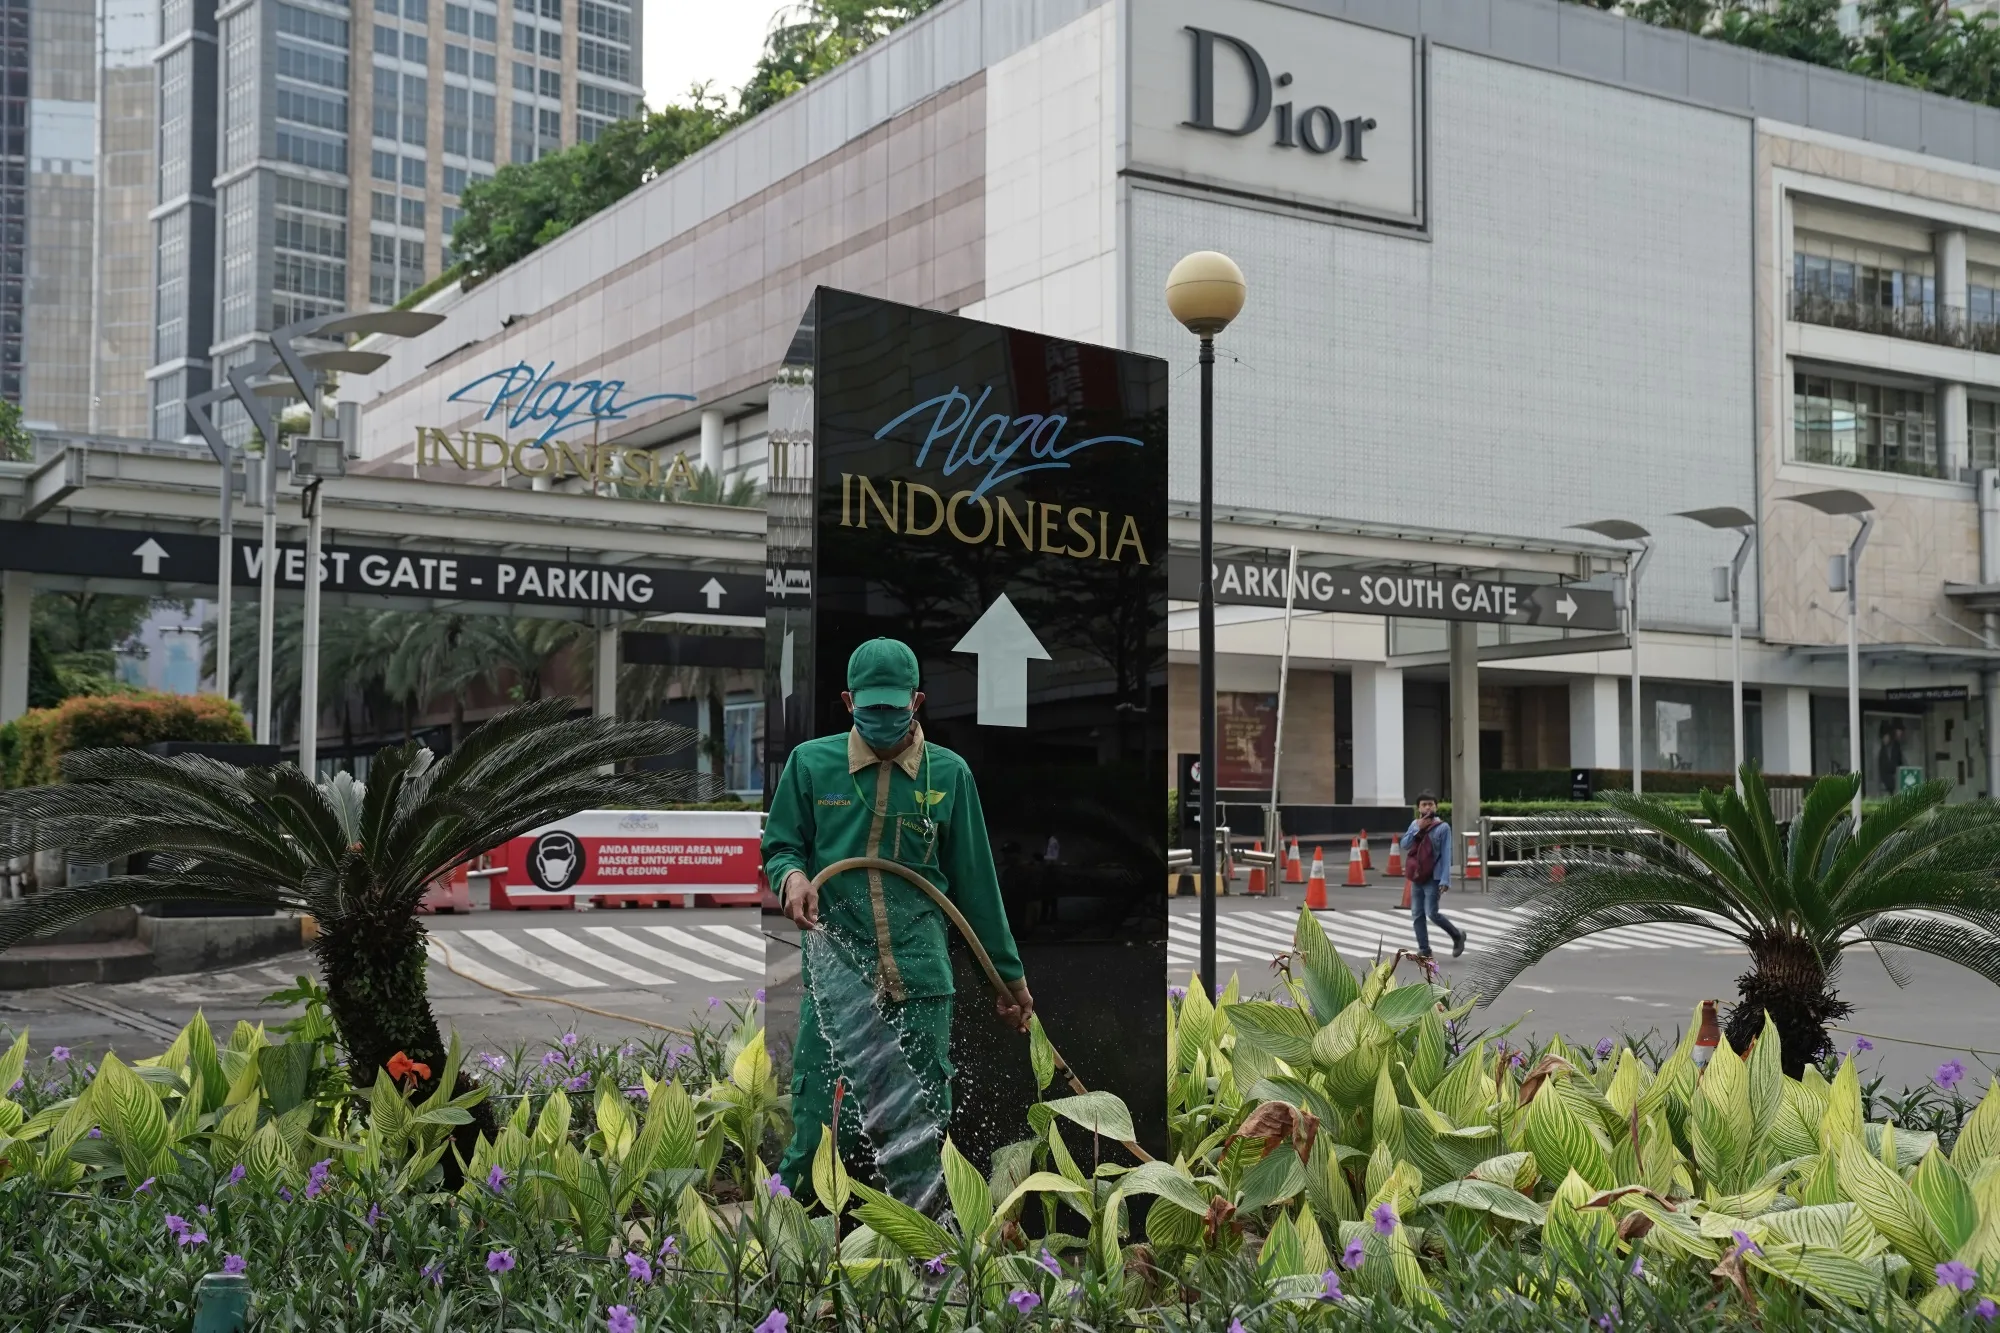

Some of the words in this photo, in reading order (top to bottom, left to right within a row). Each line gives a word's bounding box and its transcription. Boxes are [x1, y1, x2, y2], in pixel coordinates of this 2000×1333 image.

[1180, 25, 1377, 162] Dior
[447, 361, 697, 448] Plaza
[415, 426, 699, 491] INDONESIA
[873, 385, 1144, 504] Plaza
[839, 472, 1150, 566] INDONESIA
[359, 554, 458, 591] GATE
[497, 564, 654, 603] PARKING
[1359, 575, 1444, 610] SOUTH
[1451, 582, 1517, 616] GATE
[597, 866, 624, 876] AREA
[626, 866, 668, 876] GEDUNG
[598, 856, 639, 865] MASKER
[641, 856, 676, 865] UNTUK
[678, 856, 723, 865] SELURUH
[599, 845, 628, 855] ANDA
[631, 845, 684, 855] MEMASUKI
[686, 845, 712, 855] AREA
[714, 845, 743, 857] WAJIB
